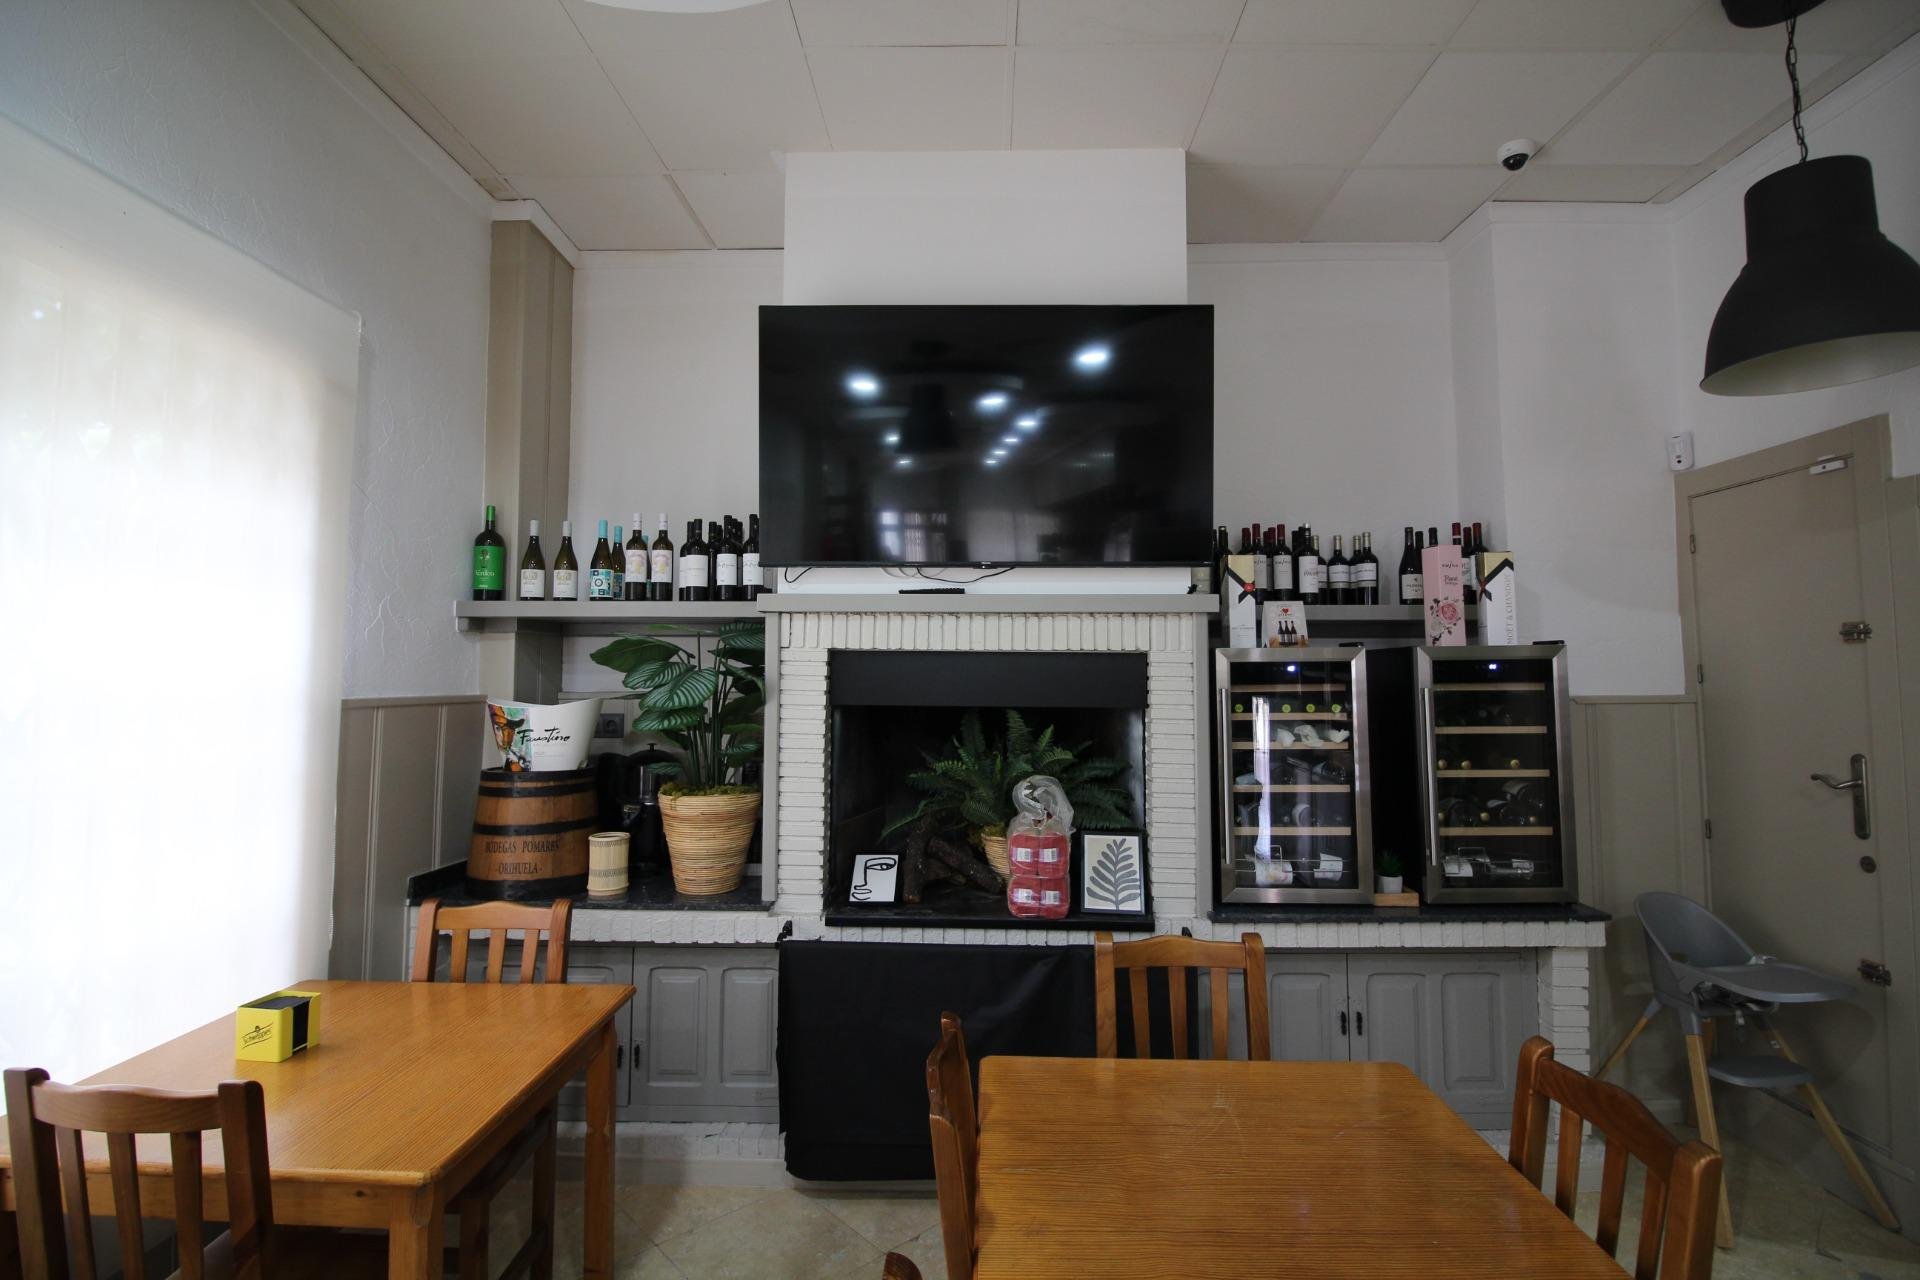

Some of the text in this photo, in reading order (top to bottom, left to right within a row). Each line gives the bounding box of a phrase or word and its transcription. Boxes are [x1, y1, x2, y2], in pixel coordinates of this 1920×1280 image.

[517, 726, 571, 745] Faustino
[485, 839, 560, 853] BODEGAS POMARES
